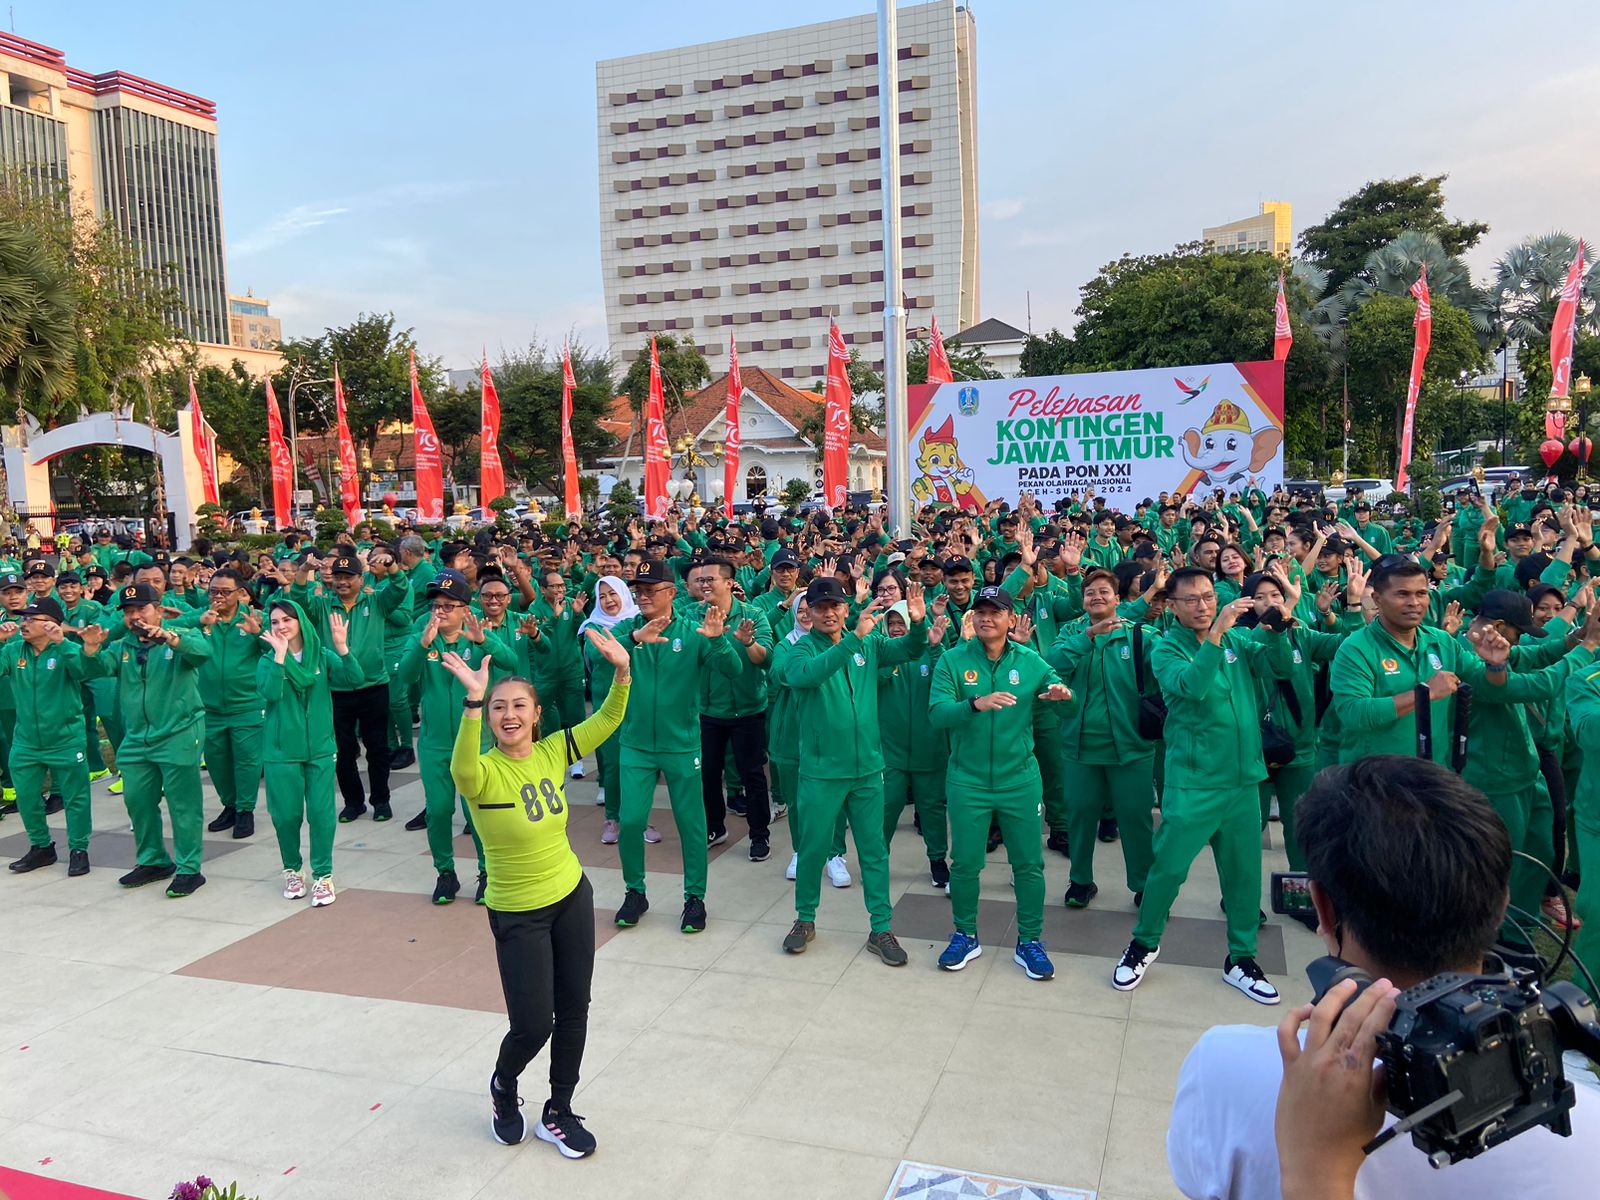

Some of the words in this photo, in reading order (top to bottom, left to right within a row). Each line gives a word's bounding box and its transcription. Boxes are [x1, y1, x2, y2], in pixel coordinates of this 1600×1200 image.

[1008, 386, 1142, 425] Pelepasan
[996, 411, 1163, 441] KONTINGEN
[986, 440, 1070, 465] JAWA
[1079, 435, 1175, 461] TIMUR
[1018, 466, 1060, 480] PADA
[1065, 464, 1099, 478] PON
[1104, 463, 1131, 477] XXI
[1018, 480, 1044, 488] PEKAN
[1046, 479, 1088, 487] OLAHRAGA
[1091, 477, 1132, 486] NASIONAL
[1101, 486, 1131, 494] 2024
[520, 778, 563, 822] 88
